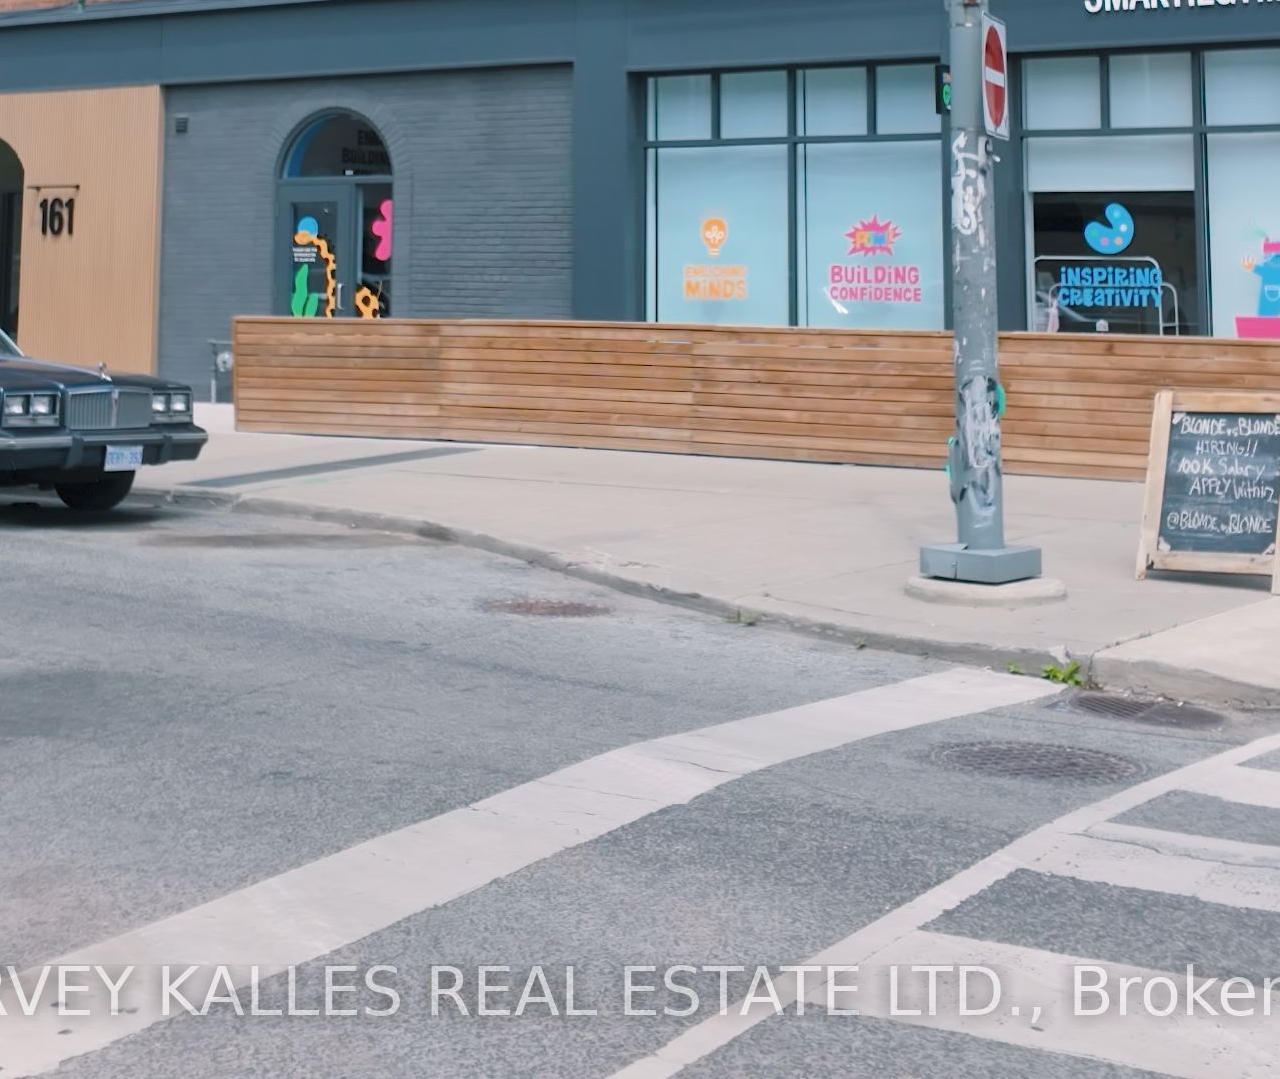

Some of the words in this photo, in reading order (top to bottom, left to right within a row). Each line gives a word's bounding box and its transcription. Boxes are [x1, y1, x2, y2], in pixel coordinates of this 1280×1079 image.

[40, 198, 74, 235] 161
[1180, 416, 1227, 436] BLONDE
[1195, 439, 1259, 457] HIRING!!
[1189, 477, 1232, 496] APPLY
